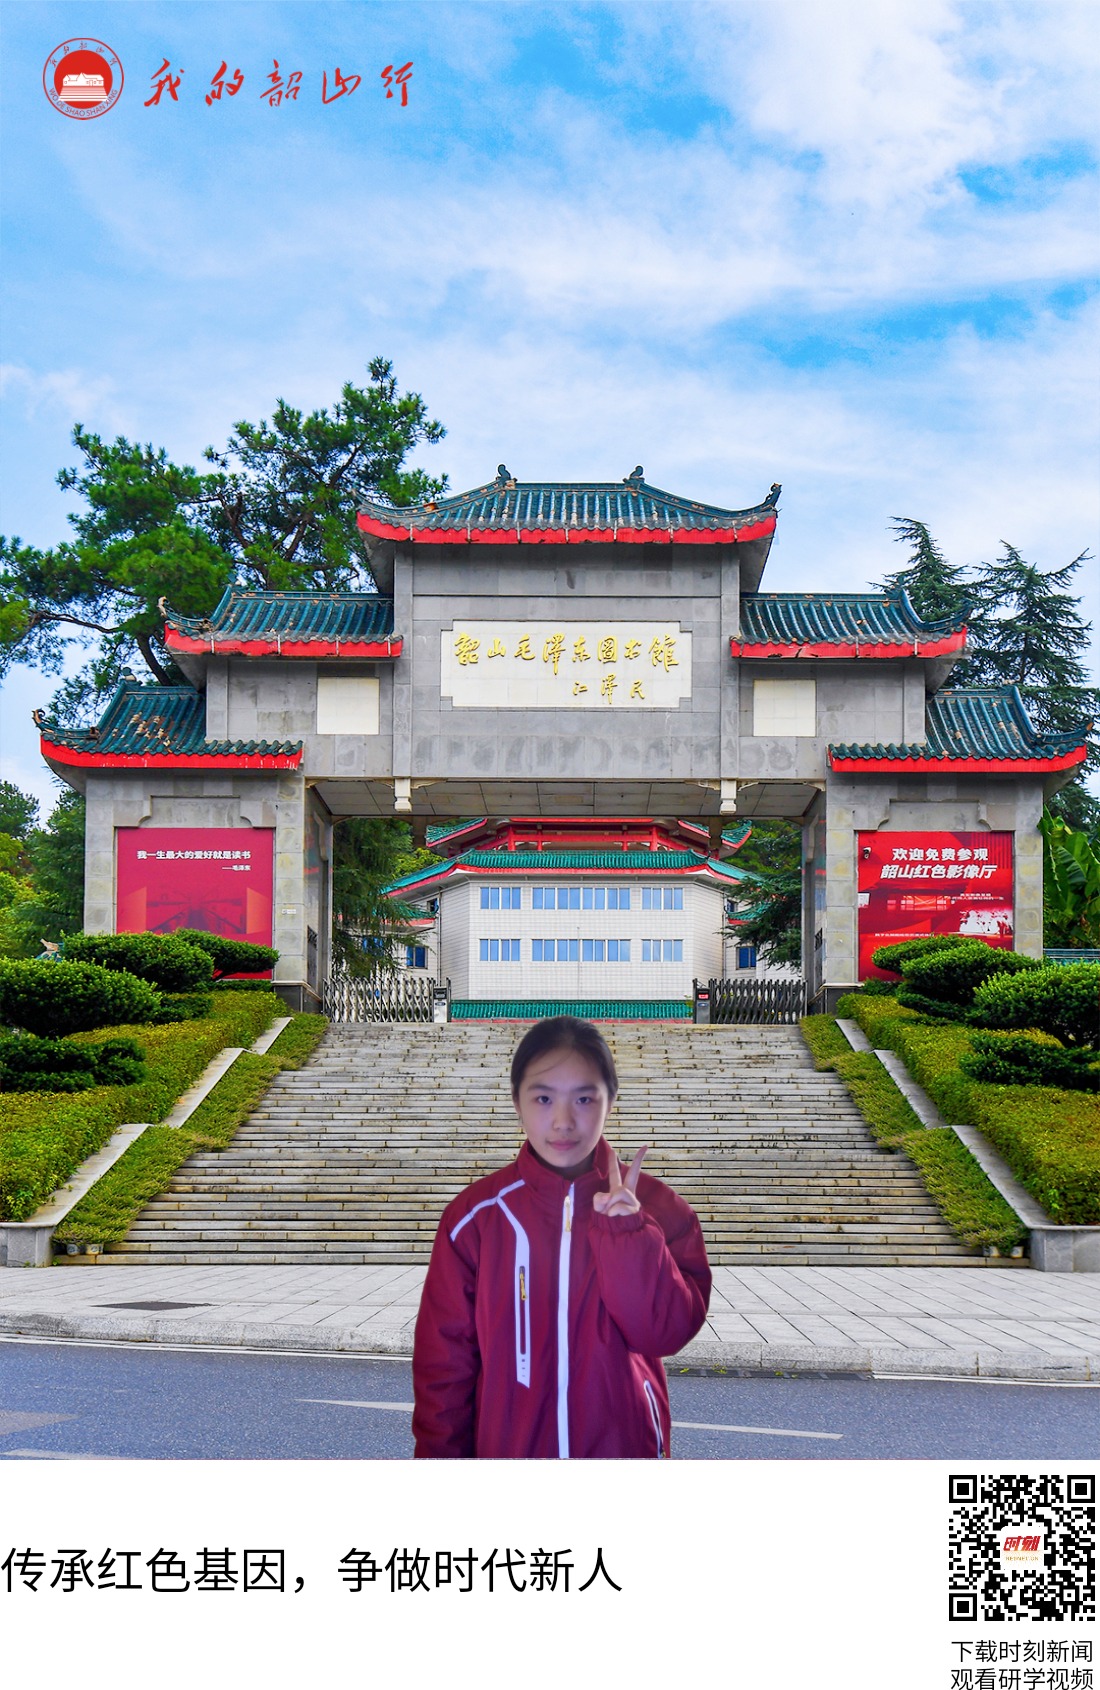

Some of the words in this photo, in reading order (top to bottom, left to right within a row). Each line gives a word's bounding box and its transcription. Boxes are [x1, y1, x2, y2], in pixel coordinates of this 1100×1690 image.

[136, 850, 251, 860] 我一生最大的爱好就是读书
[892, 848, 988, 861] 欢迎免费参观
[880, 864, 998, 879] 韶山红色影像厅
